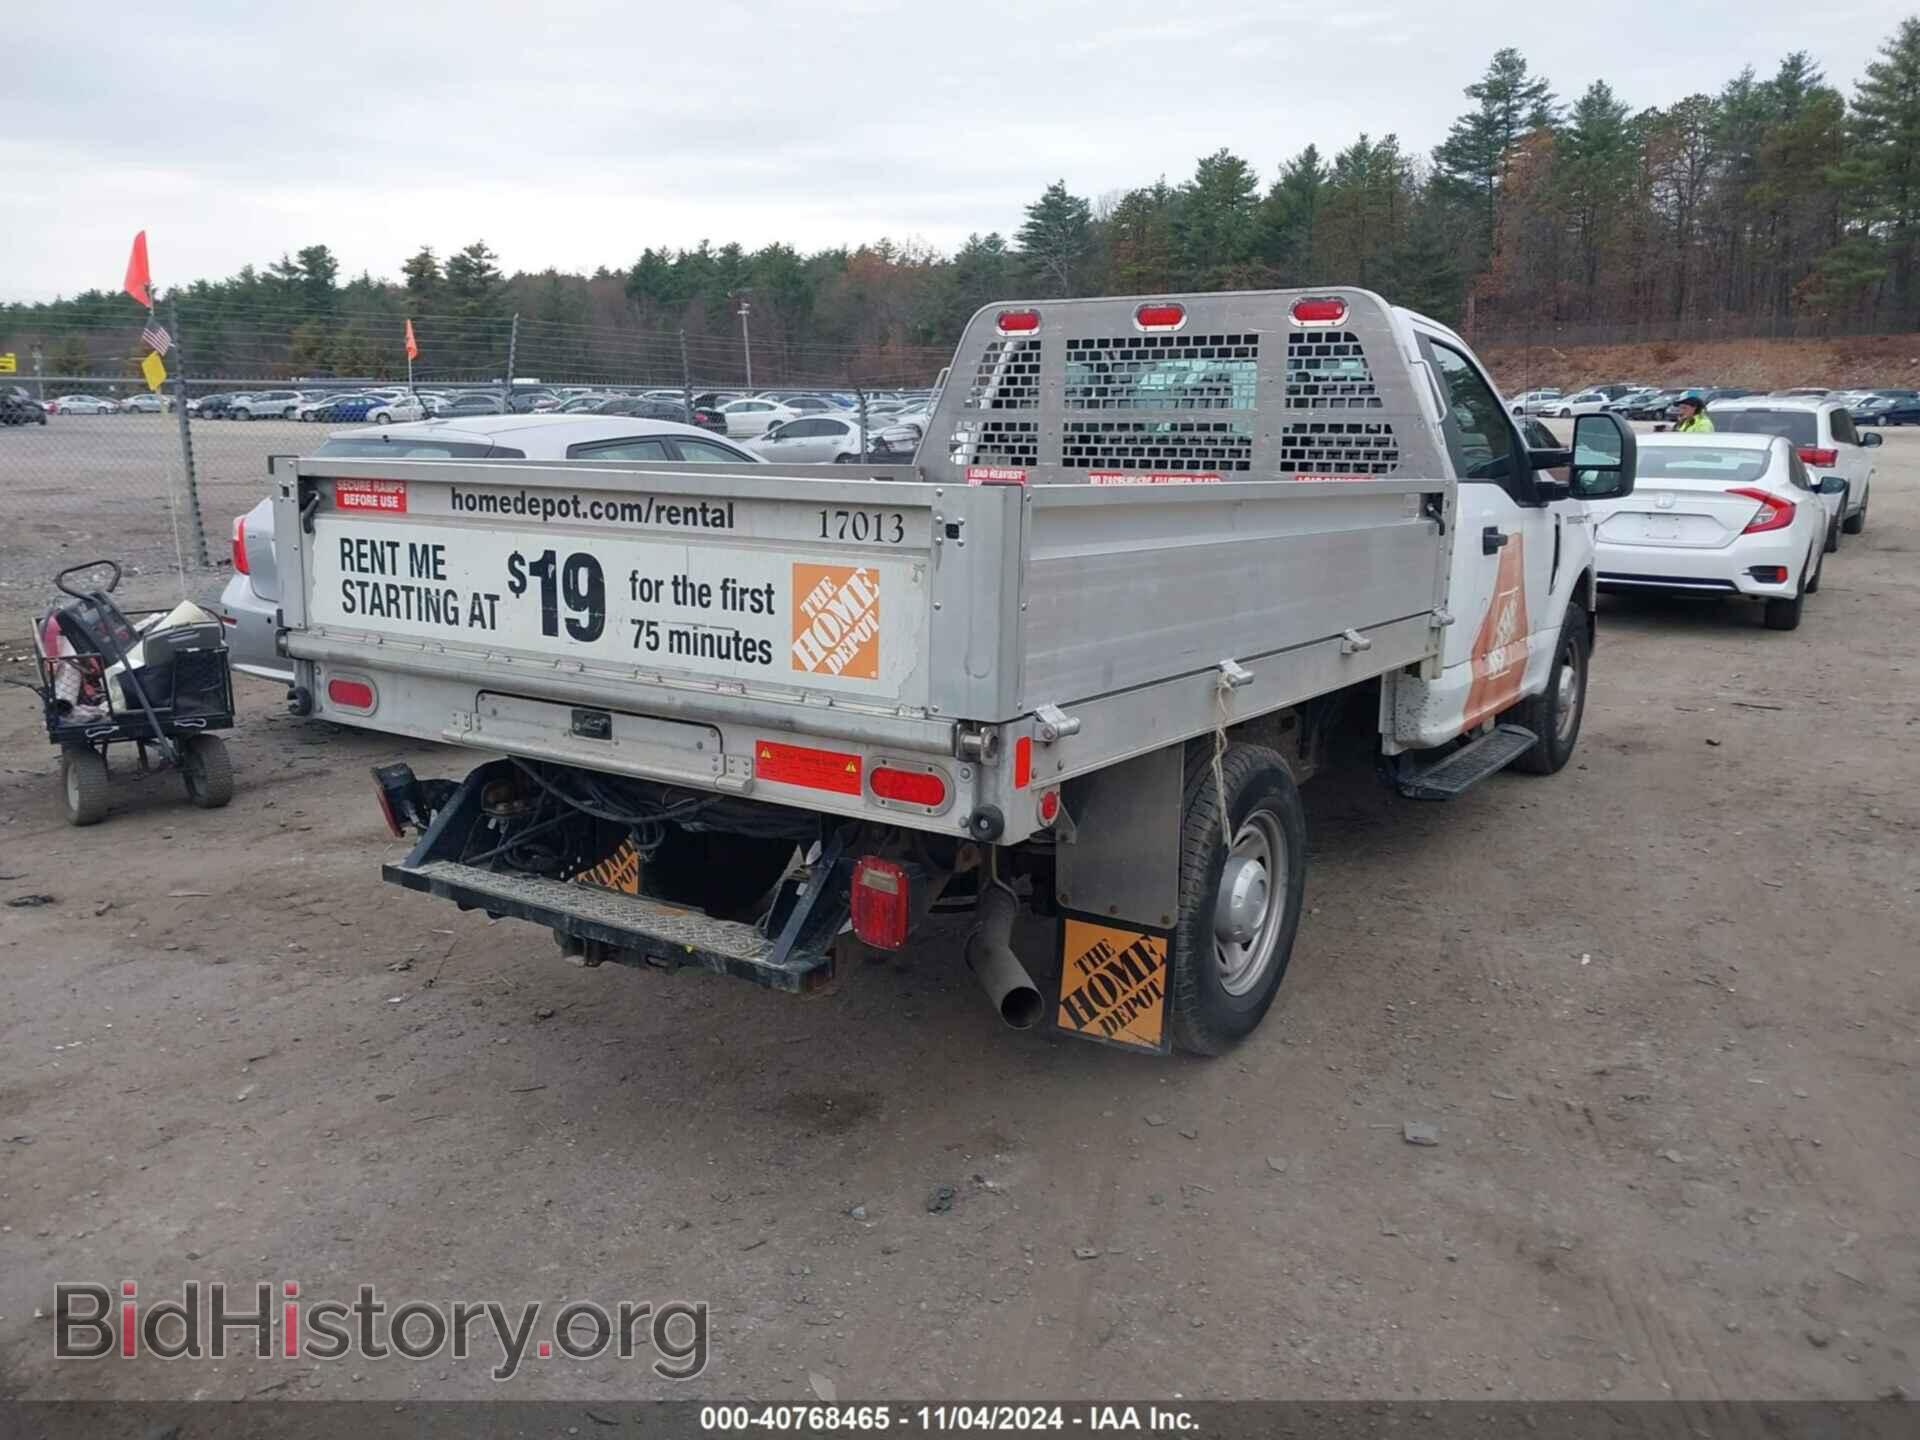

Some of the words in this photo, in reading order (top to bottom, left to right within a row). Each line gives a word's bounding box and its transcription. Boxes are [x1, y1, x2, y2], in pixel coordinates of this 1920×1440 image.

[343, 493, 379, 507] BEFORE
[380, 495, 399, 508] USE
[450, 486, 735, 529] homedepot.com/rental
[817, 509, 905, 543] 17013
[340, 537, 400, 577] RENT
[408, 542, 448, 581] ME
[341, 579, 460, 626] STARTING
[468, 592, 500, 631] AT
[507, 549, 606, 643] $19
[629, 569, 664, 604] for
[671, 573, 712, 609] the
[720, 577, 776, 615] first
[800, 575, 838, 619] THE
[629, 618, 660, 652] 75
[668, 625, 773, 665] minutes
[791, 567, 881, 672] HOME
[824, 609, 880, 675] DEPOT
[1072, 937, 1117, 977] THE
[1060, 934, 1167, 1030] HOME
[1098, 977, 1165, 1038] DEPOT
